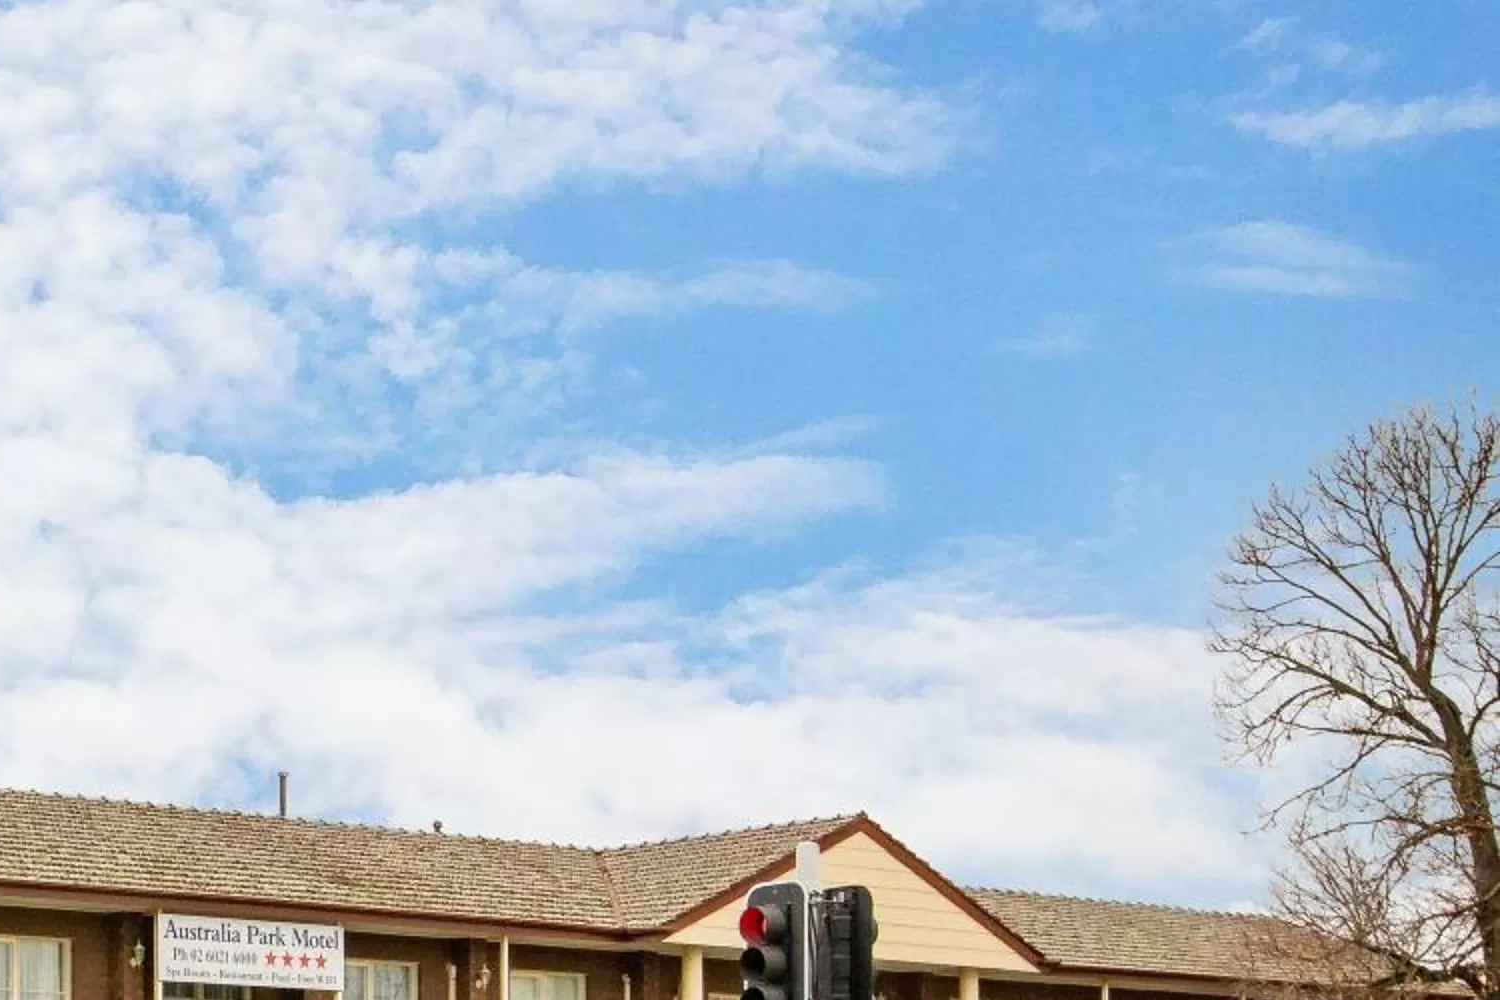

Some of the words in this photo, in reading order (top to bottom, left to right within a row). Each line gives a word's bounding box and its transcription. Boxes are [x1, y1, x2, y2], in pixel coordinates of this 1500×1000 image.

[163, 919, 241, 943] Australia
[247, 925, 287, 948] Park
[292, 928, 339, 950] Motel
